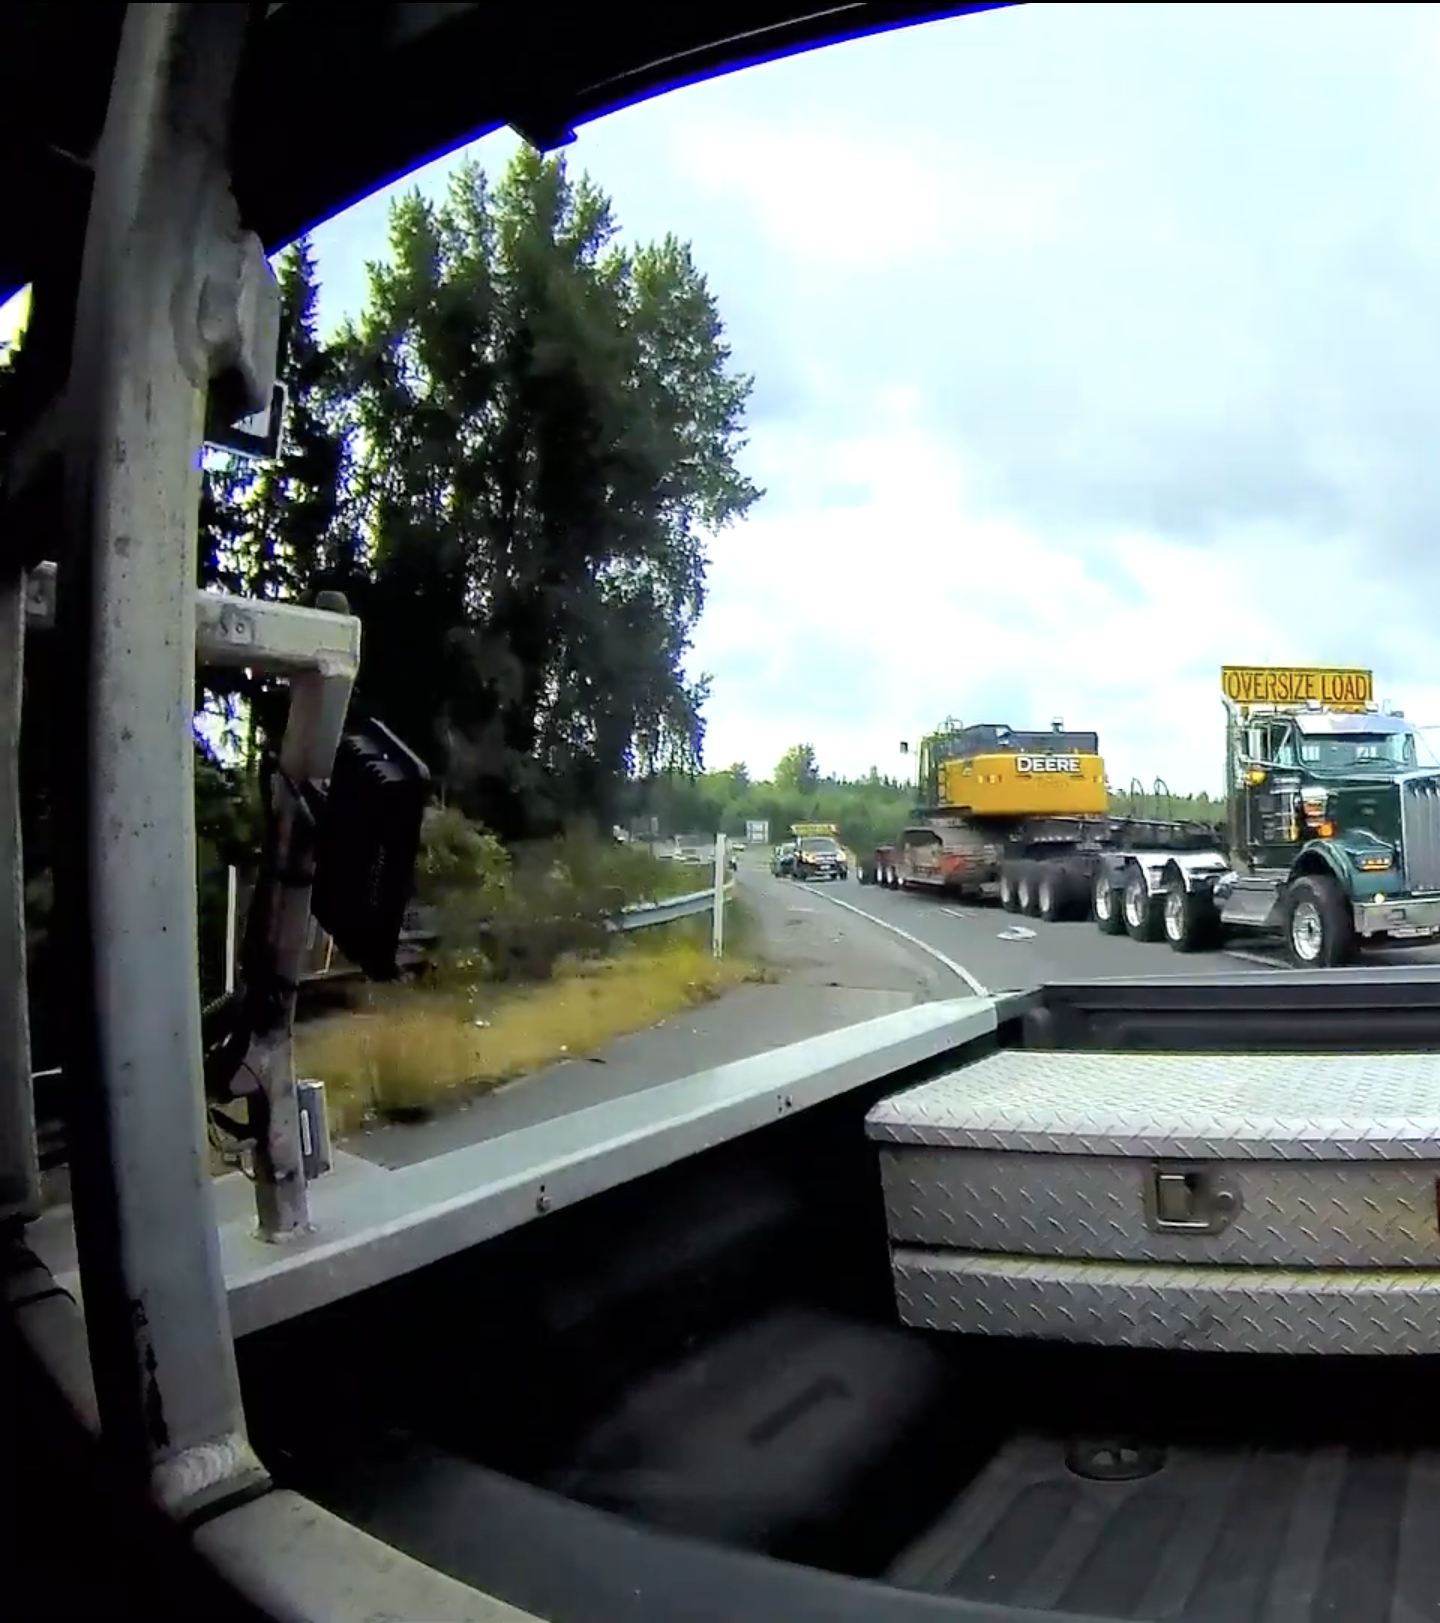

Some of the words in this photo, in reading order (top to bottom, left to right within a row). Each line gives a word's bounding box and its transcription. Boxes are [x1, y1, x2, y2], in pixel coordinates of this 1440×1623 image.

[1228, 672, 1316, 700] OVERSIZE
[1321, 674, 1367, 701] LOAD
[1017, 757, 1081, 772] DEERE
